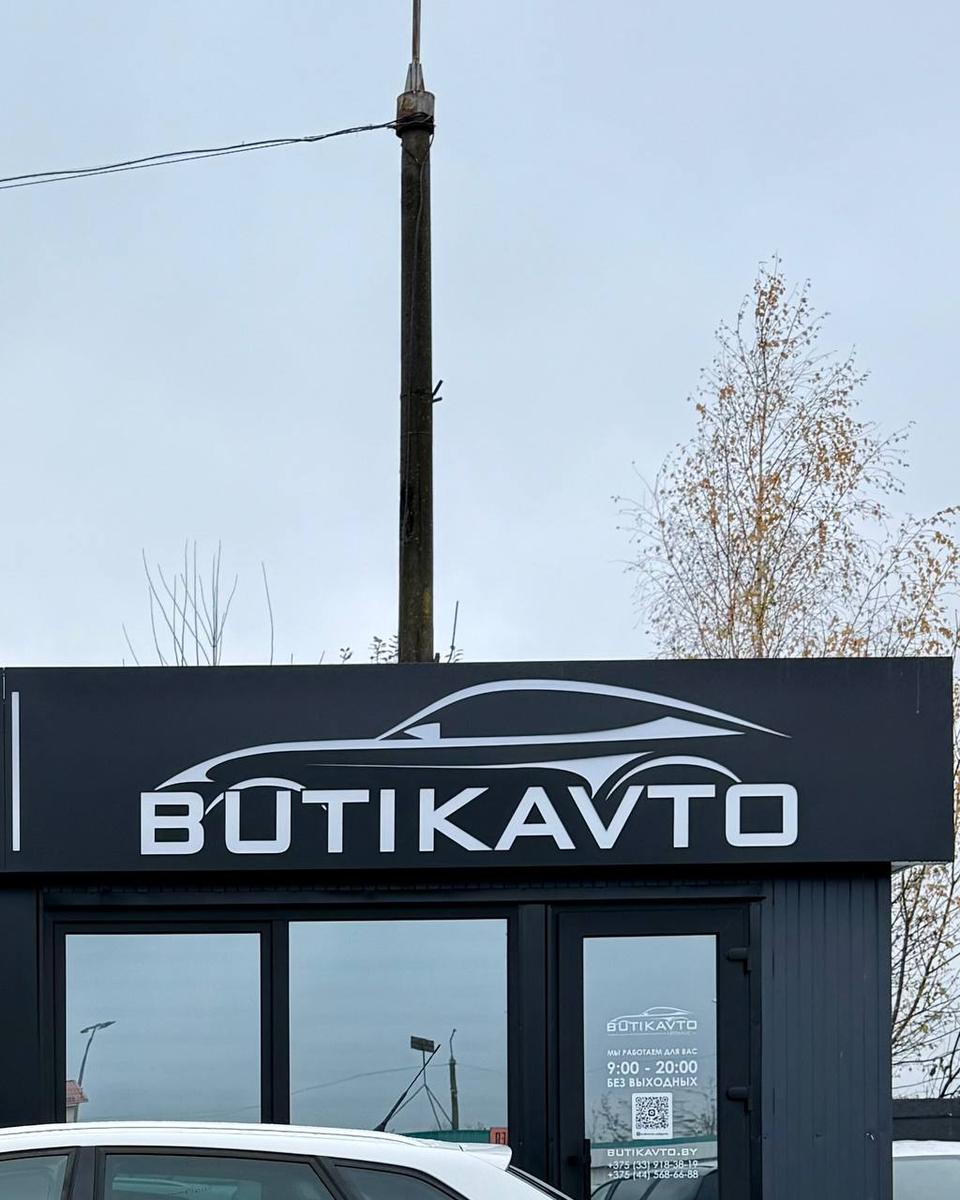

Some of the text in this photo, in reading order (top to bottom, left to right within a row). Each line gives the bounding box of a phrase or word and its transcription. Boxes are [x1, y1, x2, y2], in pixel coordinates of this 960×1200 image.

[140, 782, 799, 856] BUTIKAVTO
[607, 1020, 697, 1032] BUTIKAVTO
[664, 1048, 680, 1056] ДЛЯ
[607, 1061, 639, 1075] 9:00
[655, 1060, 698, 1074] 20:00
[607, 1077, 698, 1088] БЕЗ ВЫХОДНЫХ
[607, 1148, 698, 1157] BUTIKAVTO.BY
[608, 1160, 699, 1171] +375 (33) 918-38-19
[608, 1170, 699, 1181] +375 (44) 568-66-88
